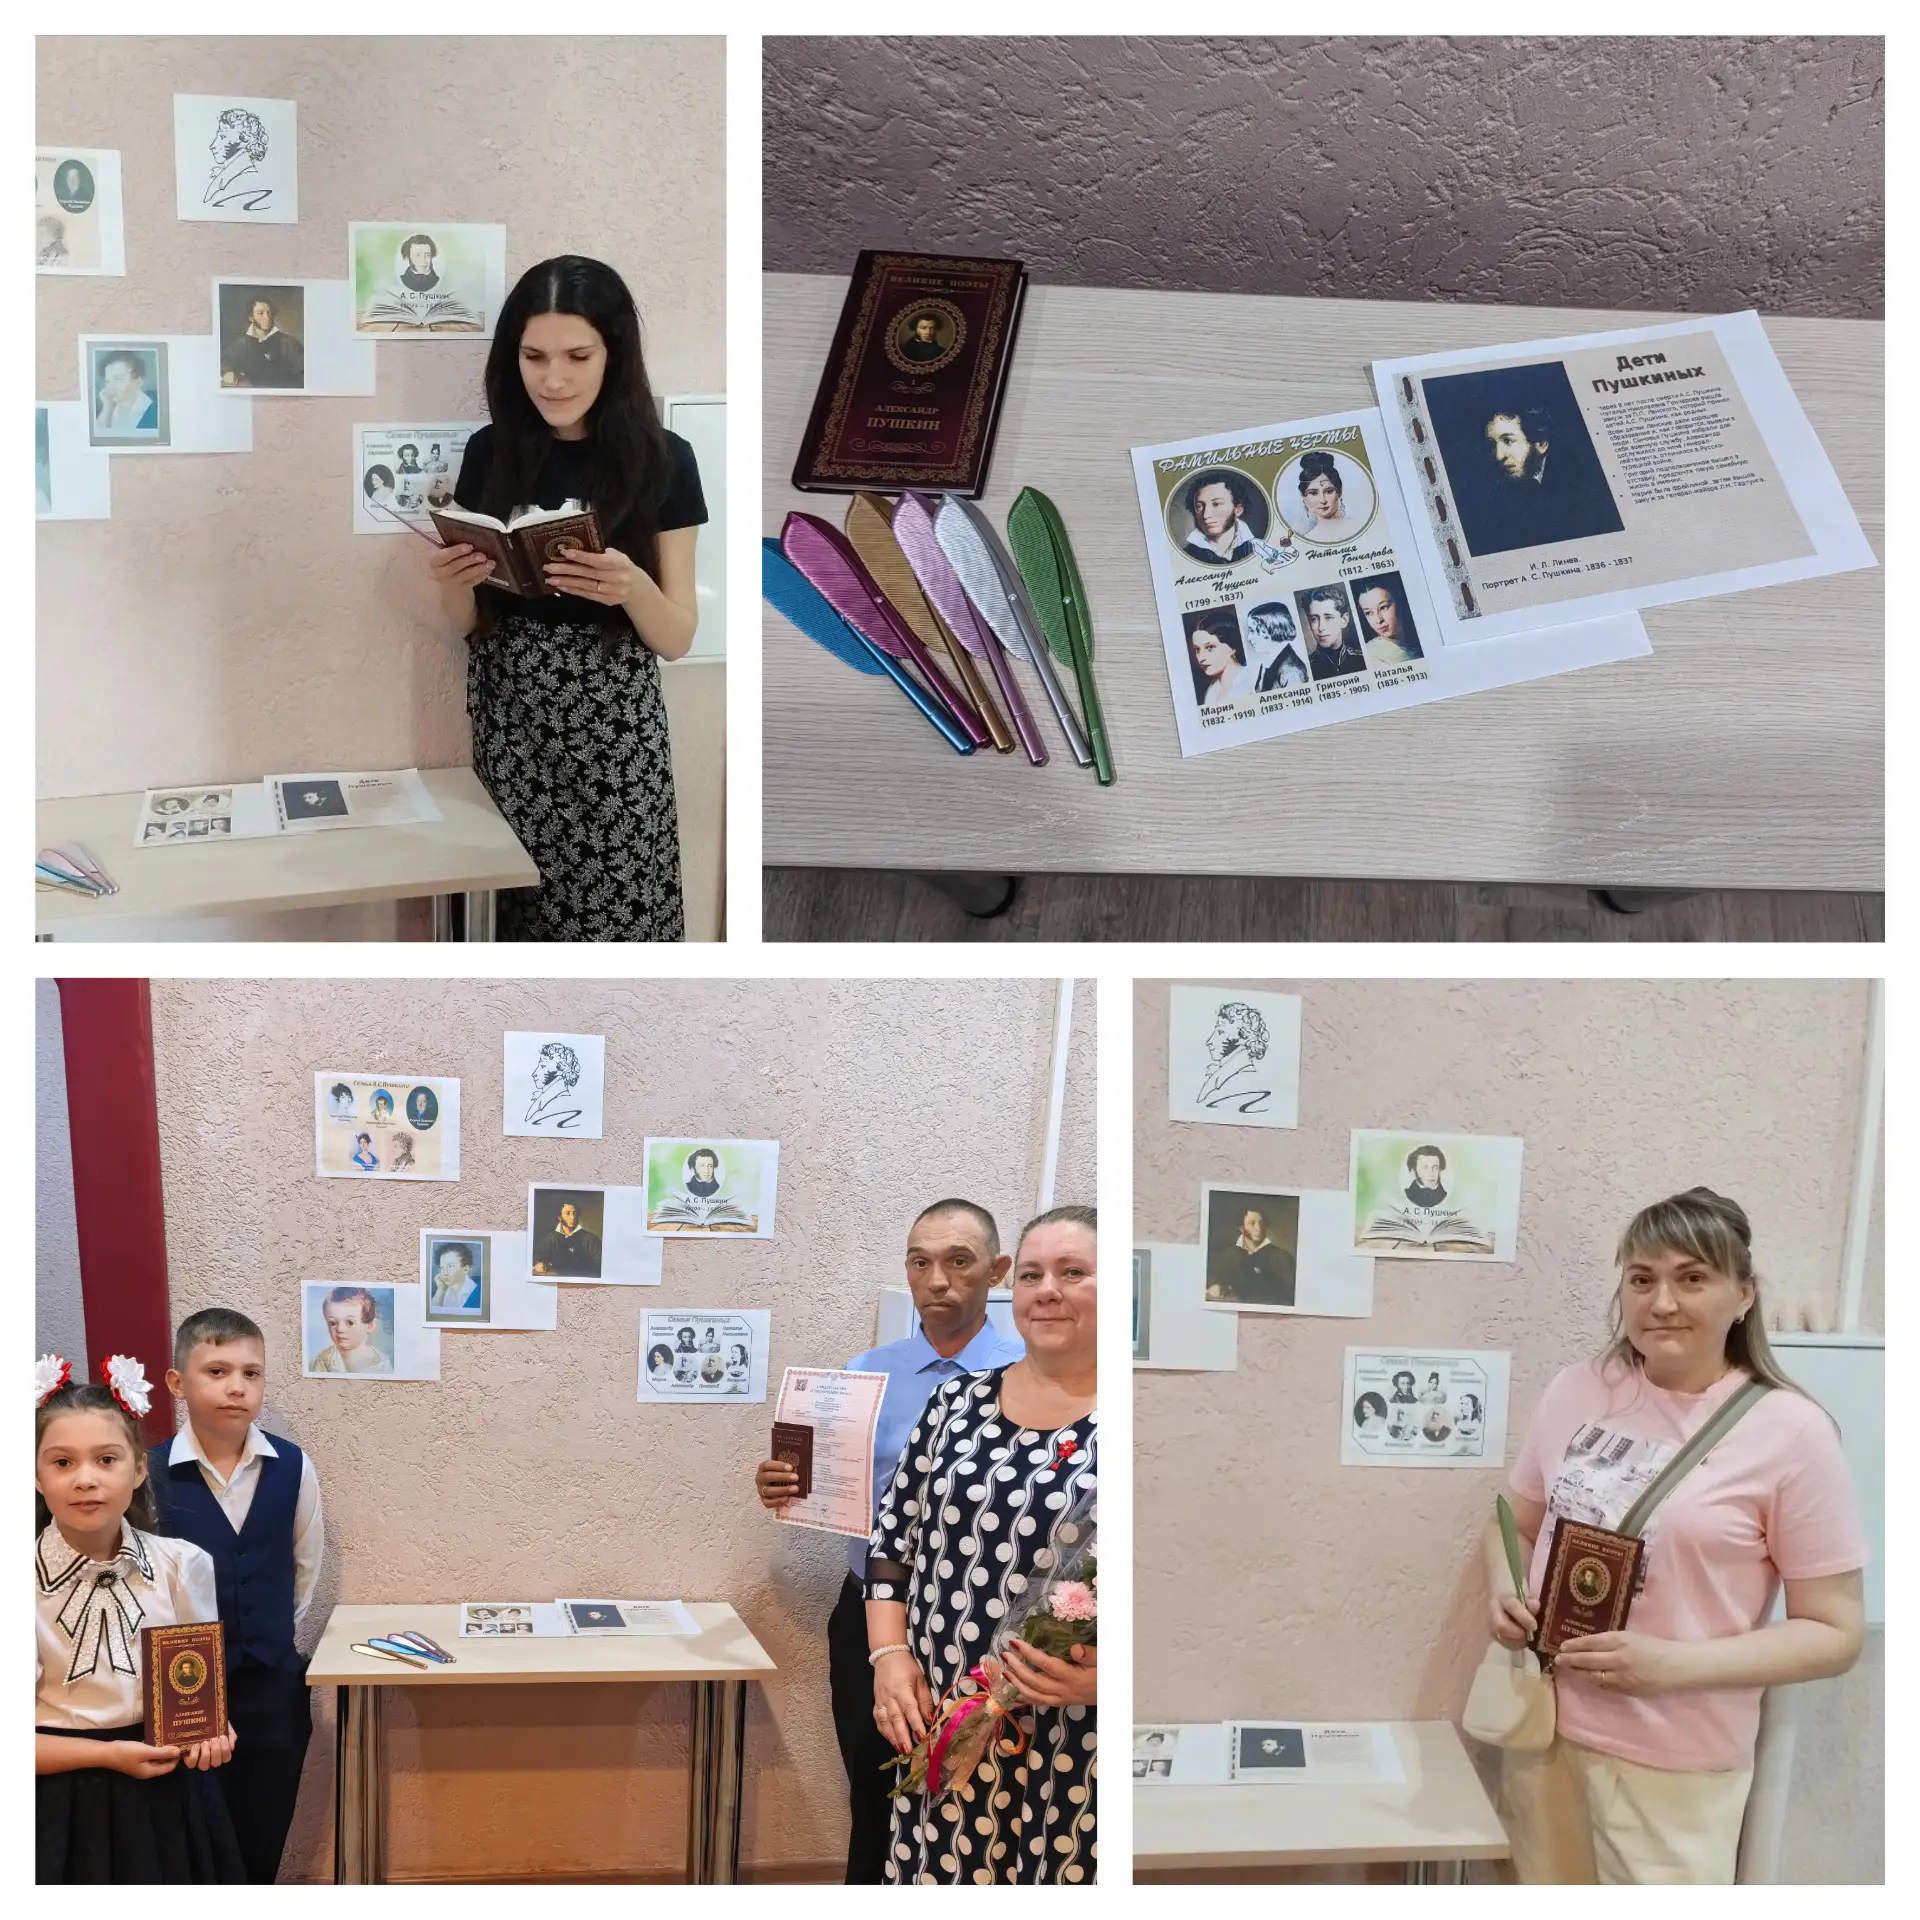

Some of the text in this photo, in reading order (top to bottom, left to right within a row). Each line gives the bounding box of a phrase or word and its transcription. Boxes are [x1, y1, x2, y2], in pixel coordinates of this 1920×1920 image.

[890, 276, 989, 288] ВЕЛИКИЕ ПОЭТЫ
[1616, 352, 1666, 372] Дети
[1592, 366, 1706, 394] Пушкиных
[1693, 387, 1720, 395] Пушкина
[874, 405, 939, 415] АЛЕКСАНДР
[867, 417, 940, 430] ПУШКИН
[1159, 426, 1358, 473] ФАМИЛЬНЫЕ ЧЕРТЫ
[1341, 548, 1393, 565] Гончарова
[1339, 565, 1363, 577] (1812
[1371, 559, 1395, 571] 1863)
[1482, 577, 1519, 590] Портрет
[1586, 561, 1606, 571] 1836
[1614, 556, 1633, 567] 1837
[1174, 570, 1234, 587] Александр
[1212, 577, 1259, 593] Пушкин
[1185, 598, 1210, 610] (1799
[1220, 591, 1244, 605] 1837)
[1374, 664, 1413, 679] Наталья
[1316, 676, 1360, 691] Григорий
[1377, 678, 1400, 690] (1836
[1407, 671, 1428, 684] 1913)
[1259, 687, 1311, 705] Александр
[1319, 691, 1341, 703] (1835
[1349, 684, 1370, 696] 1905)
[1200, 704, 1234, 716] Мария
[1260, 704, 1284, 716] (1833
[1292, 696, 1313, 710] 1914)
[1202, 716, 1225, 728] (1832
[1233, 709, 1256, 722] 1919)
[173, 1717, 207, 1726] ПУШКИН
